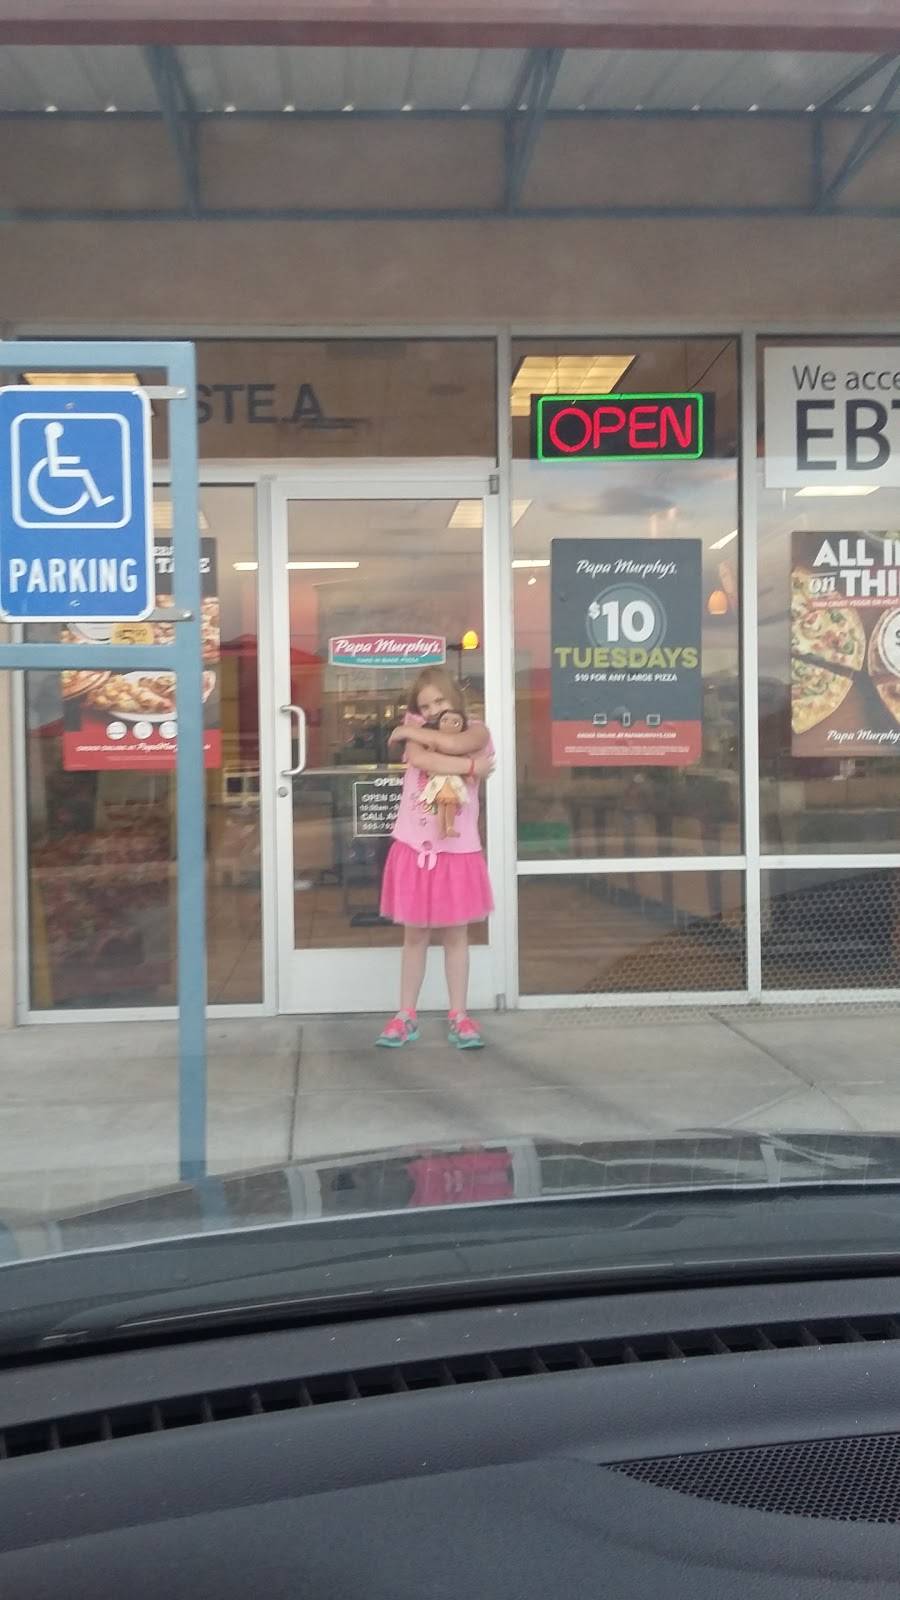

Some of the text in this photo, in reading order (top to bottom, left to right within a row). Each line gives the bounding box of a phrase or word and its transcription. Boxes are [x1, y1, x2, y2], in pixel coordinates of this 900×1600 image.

[792, 364, 836, 391] We
[292, 383, 323, 424] A
[549, 404, 692, 453] OPEN
[796, 398, 900, 471] EB
[812, 538, 874, 567] ALL
[9, 558, 138, 593] PARKING
[576, 559, 612, 579] Papa
[808, 576, 836, 594] on
[588, 600, 655, 643] $10
[335, 639, 372, 656] Papa
[554, 647, 699, 669] TUESDAYS
[575, 673, 678, 681] $10 FOR ANY LARGE PIZZA
[827, 729, 855, 744] Papa
[361, 793, 388, 802] OPEN
[360, 812, 385, 821] CALL
